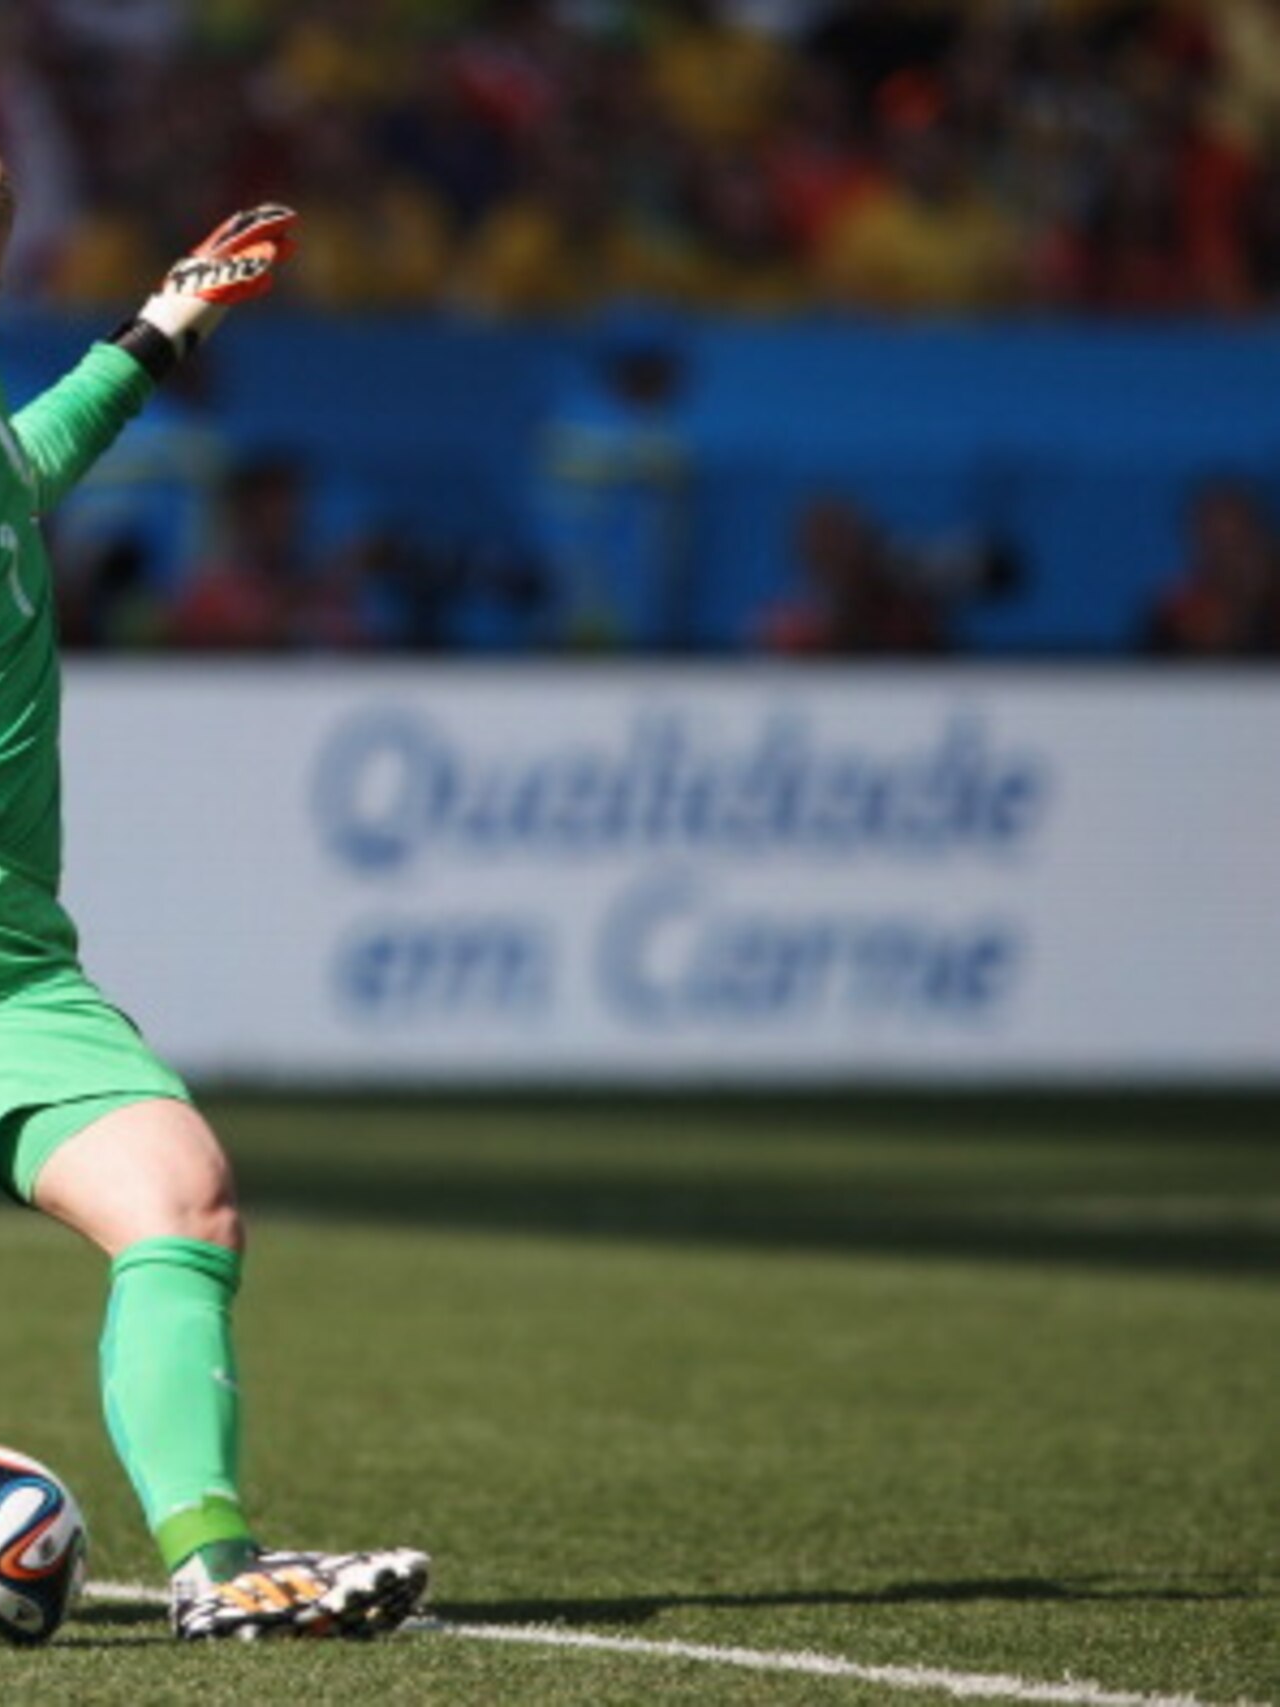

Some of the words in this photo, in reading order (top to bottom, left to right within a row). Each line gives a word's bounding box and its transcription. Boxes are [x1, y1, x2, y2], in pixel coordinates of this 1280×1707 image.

[316, 702, 1042, 868] Qualidade
[332, 915, 554, 1024] em
[596, 868, 1024, 1032] Carne
